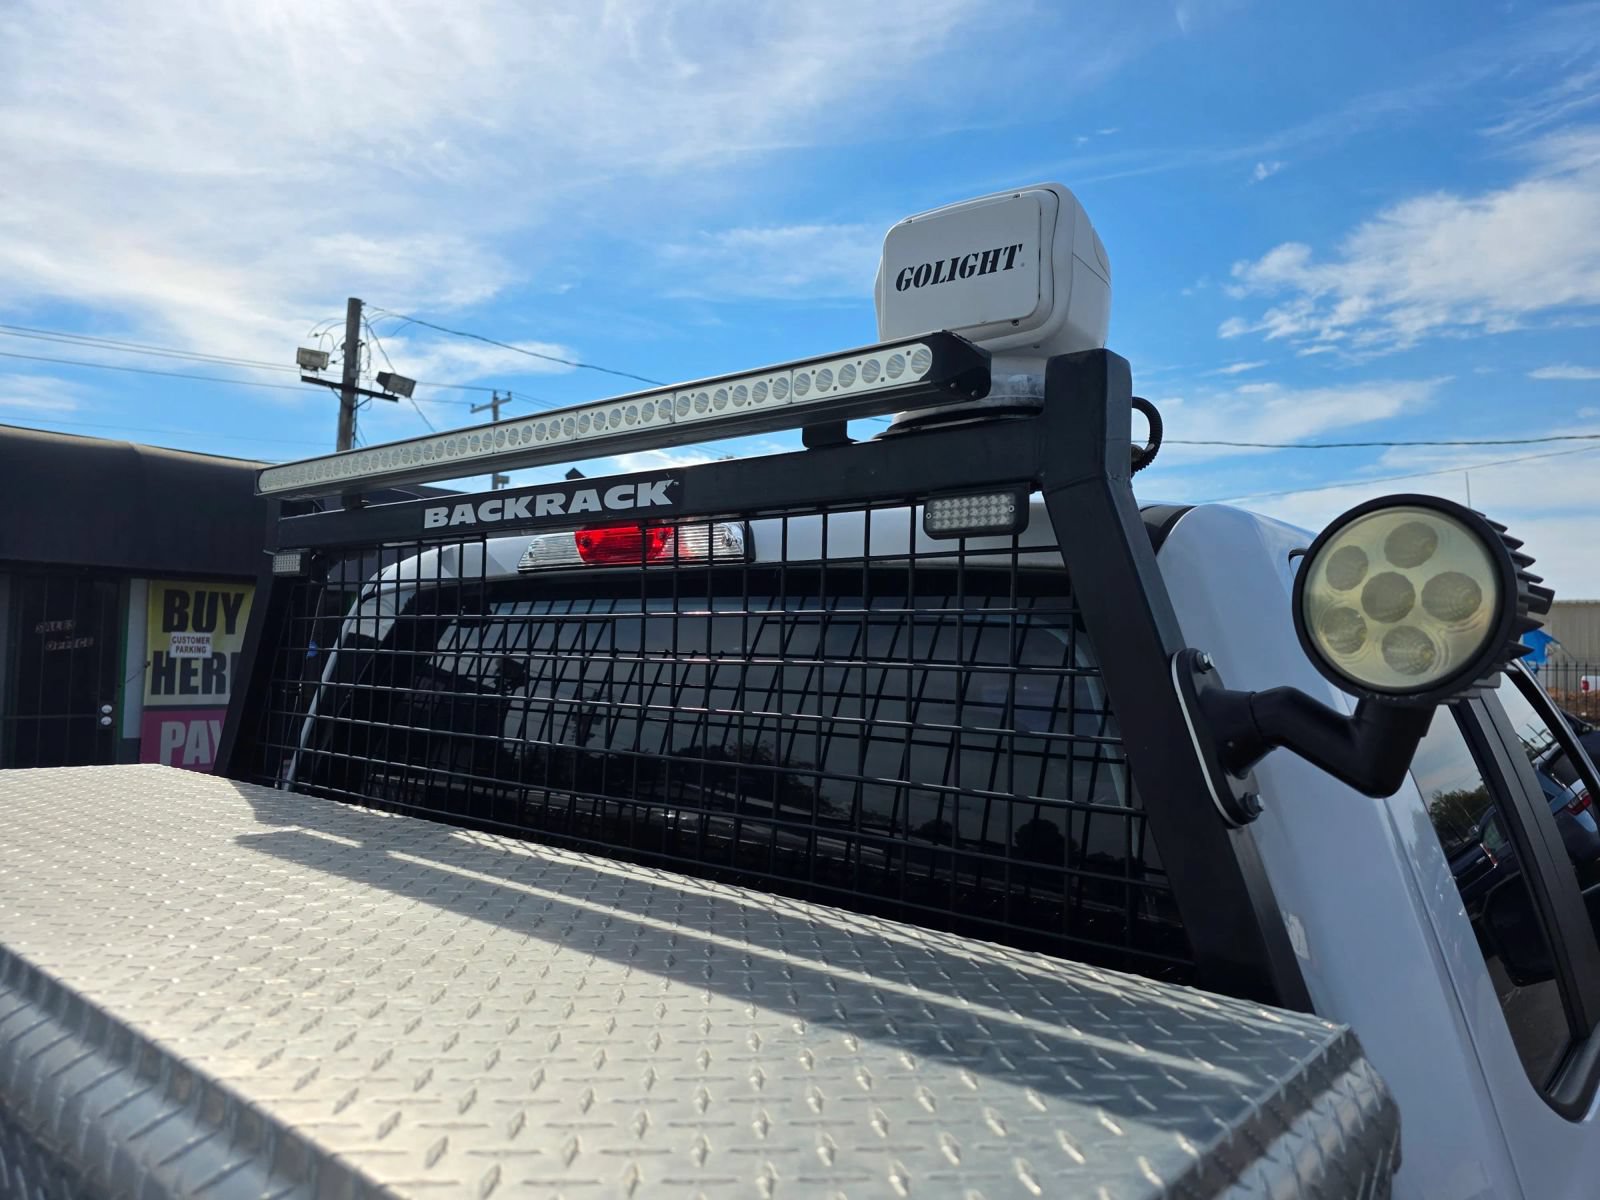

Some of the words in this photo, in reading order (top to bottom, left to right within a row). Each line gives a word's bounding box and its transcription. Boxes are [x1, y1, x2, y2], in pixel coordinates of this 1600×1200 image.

[896, 244, 1023, 291] GOLIGHT
[424, 480, 674, 529] BACKRACK
[163, 589, 245, 634] BUY
[171, 636, 210, 645] CUSTOMER
[175, 645, 206, 655] PARKING
